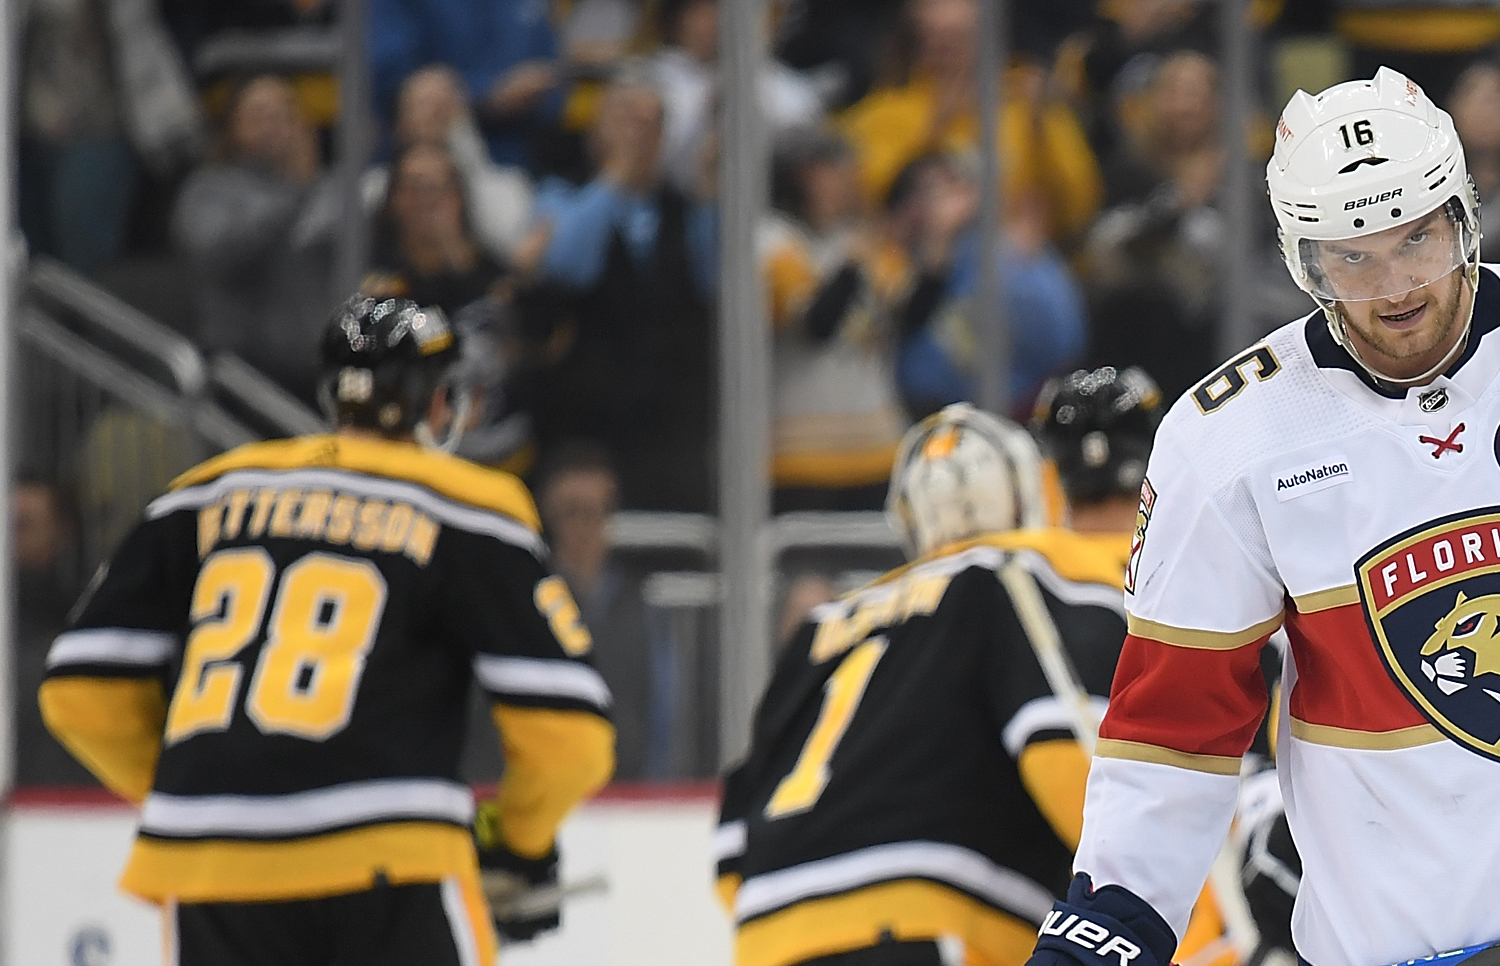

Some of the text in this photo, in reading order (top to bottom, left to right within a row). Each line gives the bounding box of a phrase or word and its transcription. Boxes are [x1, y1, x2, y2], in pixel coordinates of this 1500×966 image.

[1339, 119, 1374, 149] 16
[1343, 188, 1403, 211] BAUER
[1277, 462, 1348, 491] AutoNation
[165, 545, 387, 741] 28
[764, 634, 890, 820] 1
